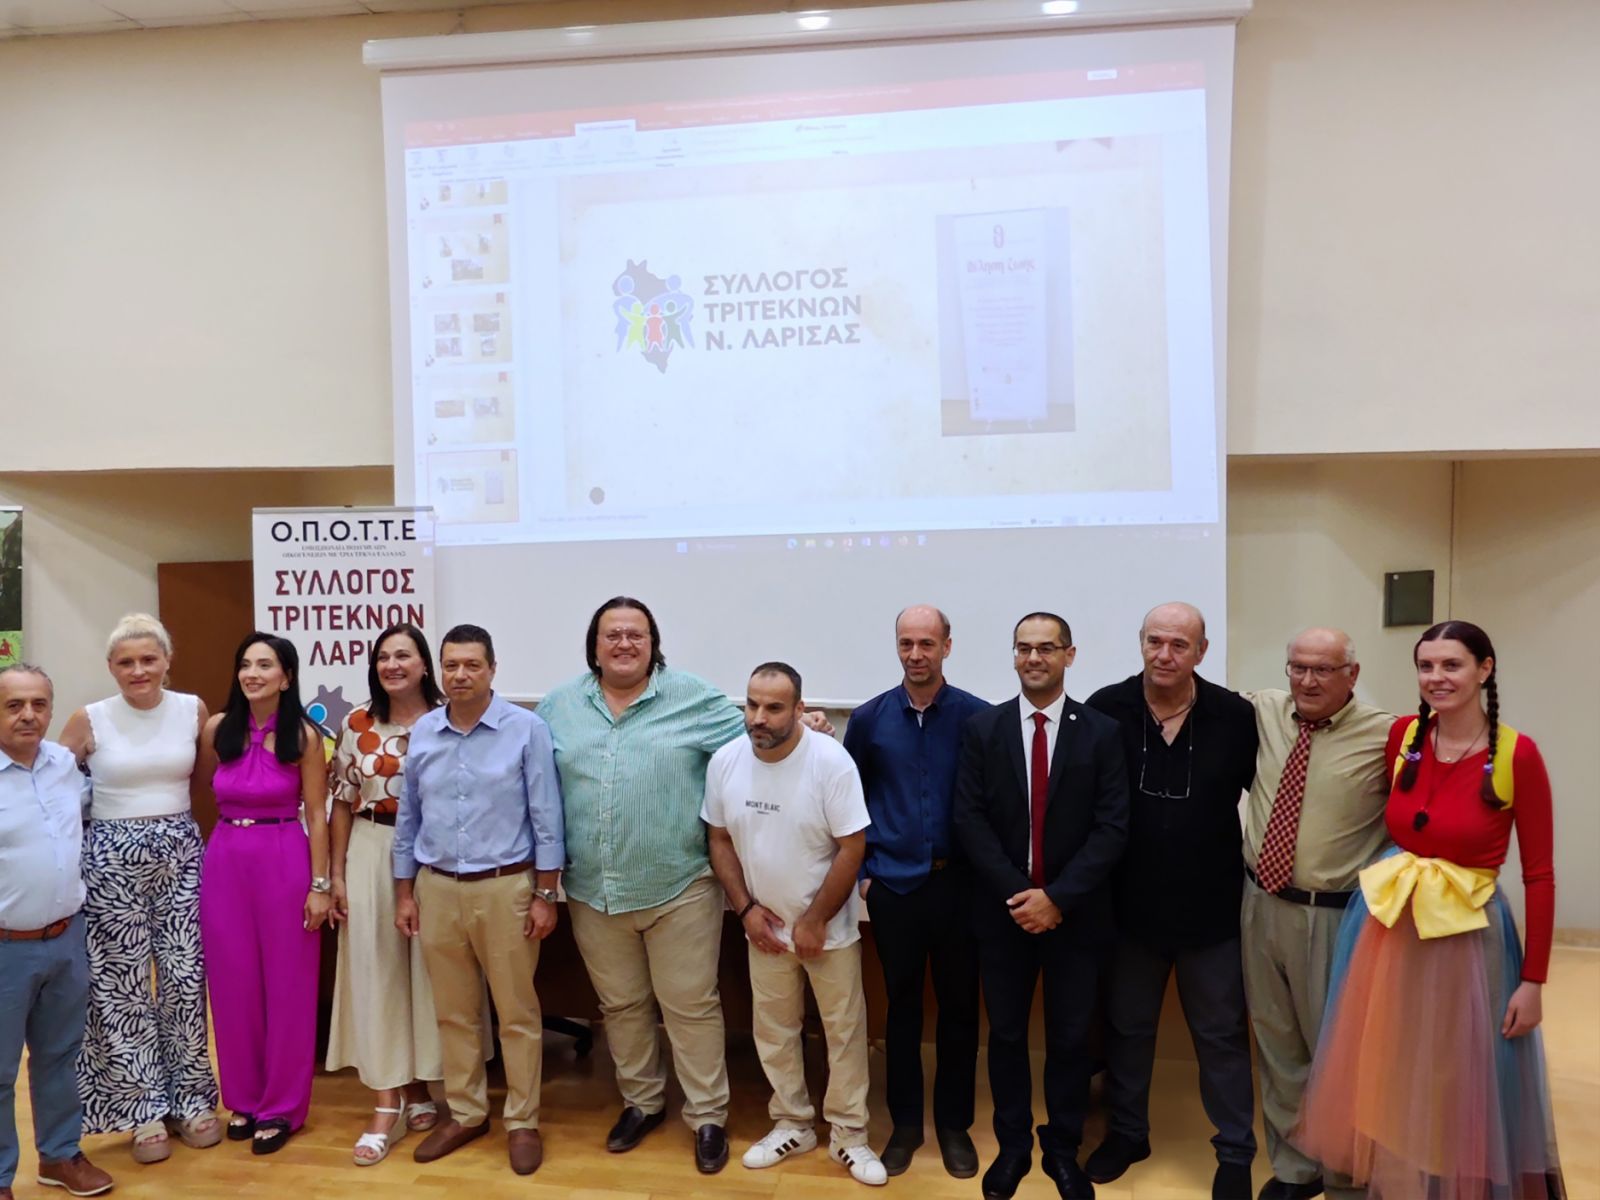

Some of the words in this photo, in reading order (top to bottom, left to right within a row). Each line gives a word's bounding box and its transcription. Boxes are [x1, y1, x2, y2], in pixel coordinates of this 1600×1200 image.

[703, 267, 848, 296] ΣΥΛΛΟΓΟΣ
[703, 295, 862, 324] ΤΡΙΤΕΚΝΩΝ
[705, 330, 733, 351] Ν.
[742, 323, 861, 350] ΛΑΡΙΣΑΣ
[275, 568, 415, 596] ΣΥΛΛΟΓΟΣ
[268, 603, 424, 631] ΤΡΙΤΕΚΝΩΝ
[309, 640, 373, 666] ΛΑΡΙ
